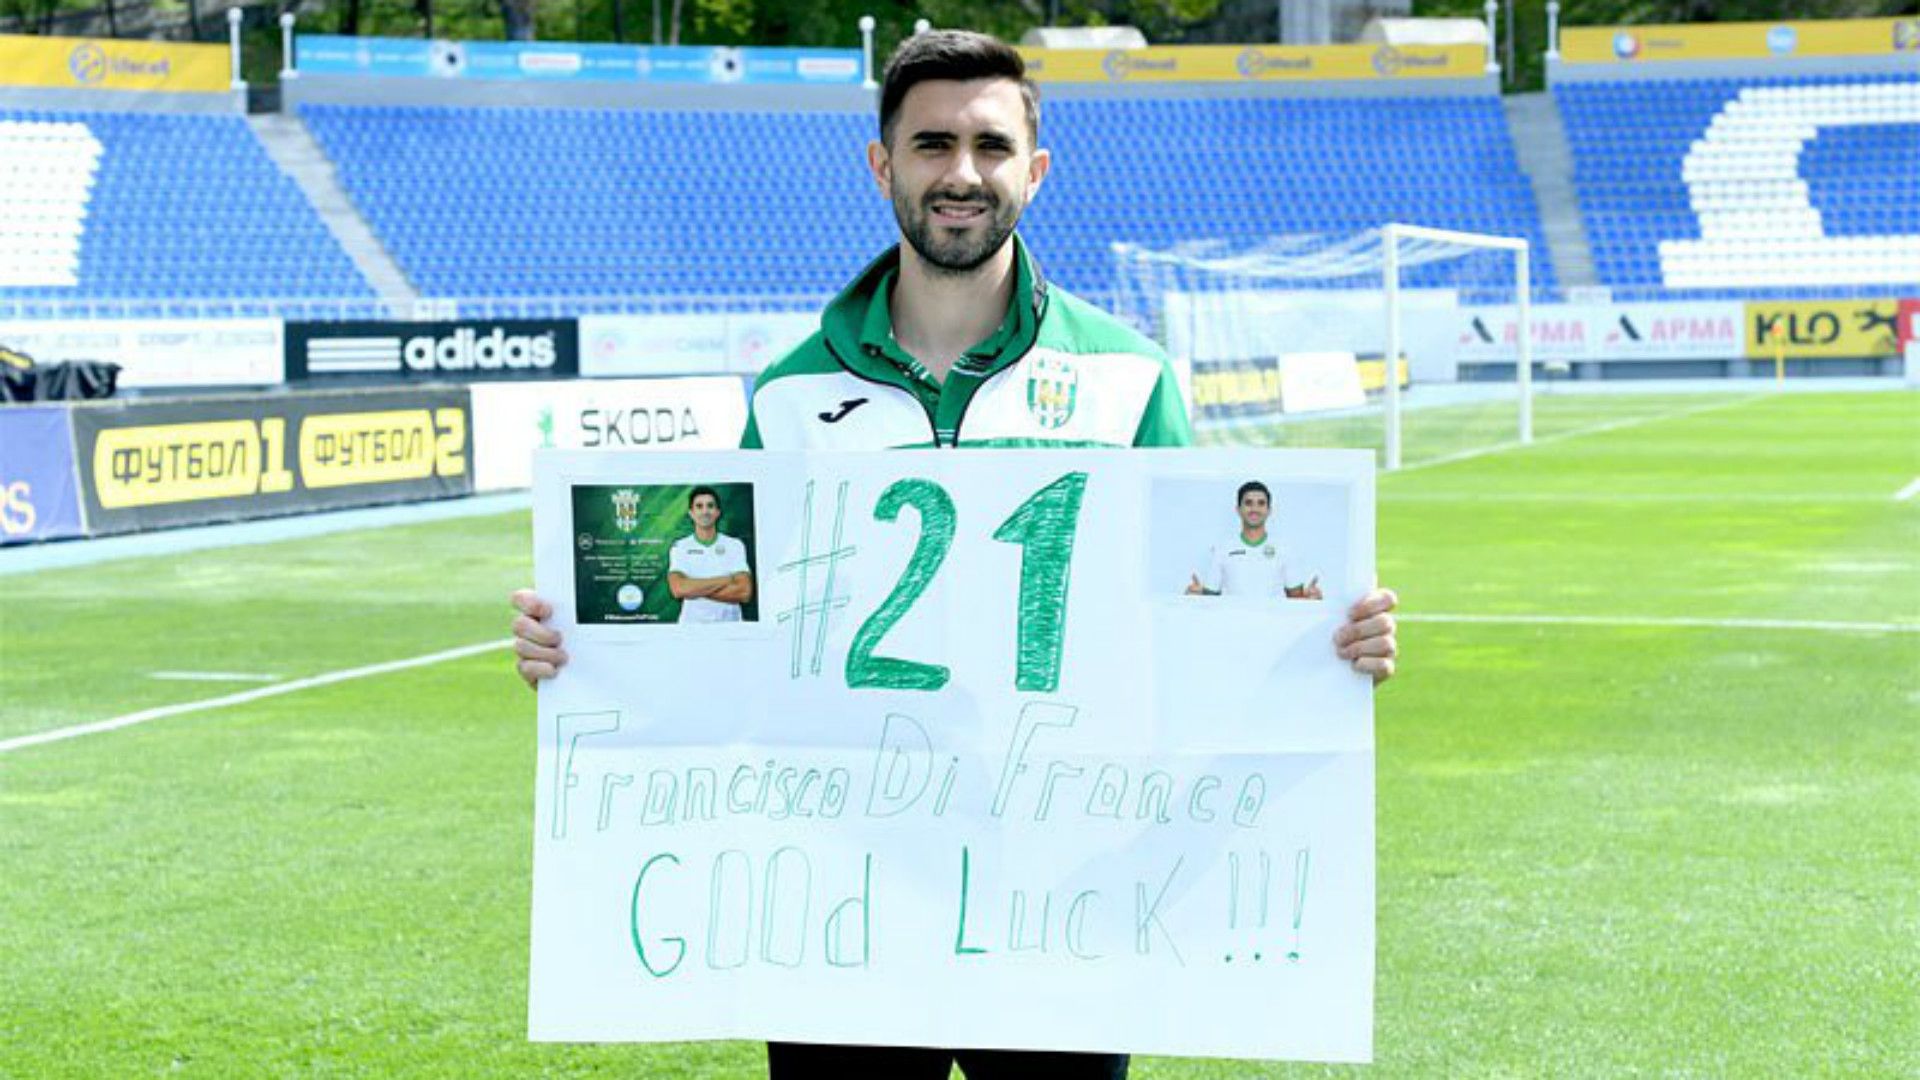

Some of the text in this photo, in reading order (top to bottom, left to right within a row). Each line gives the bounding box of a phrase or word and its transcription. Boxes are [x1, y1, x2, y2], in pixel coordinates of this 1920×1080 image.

[404, 327, 557, 371] adidas
[1756, 311, 1841, 345] KLO
[112, 417, 294, 493] ФУТБОЛ 1
[314, 408, 465, 476] ФУТБОЛ 2
[552, 700, 1267, 840] Francisco Di Franco
